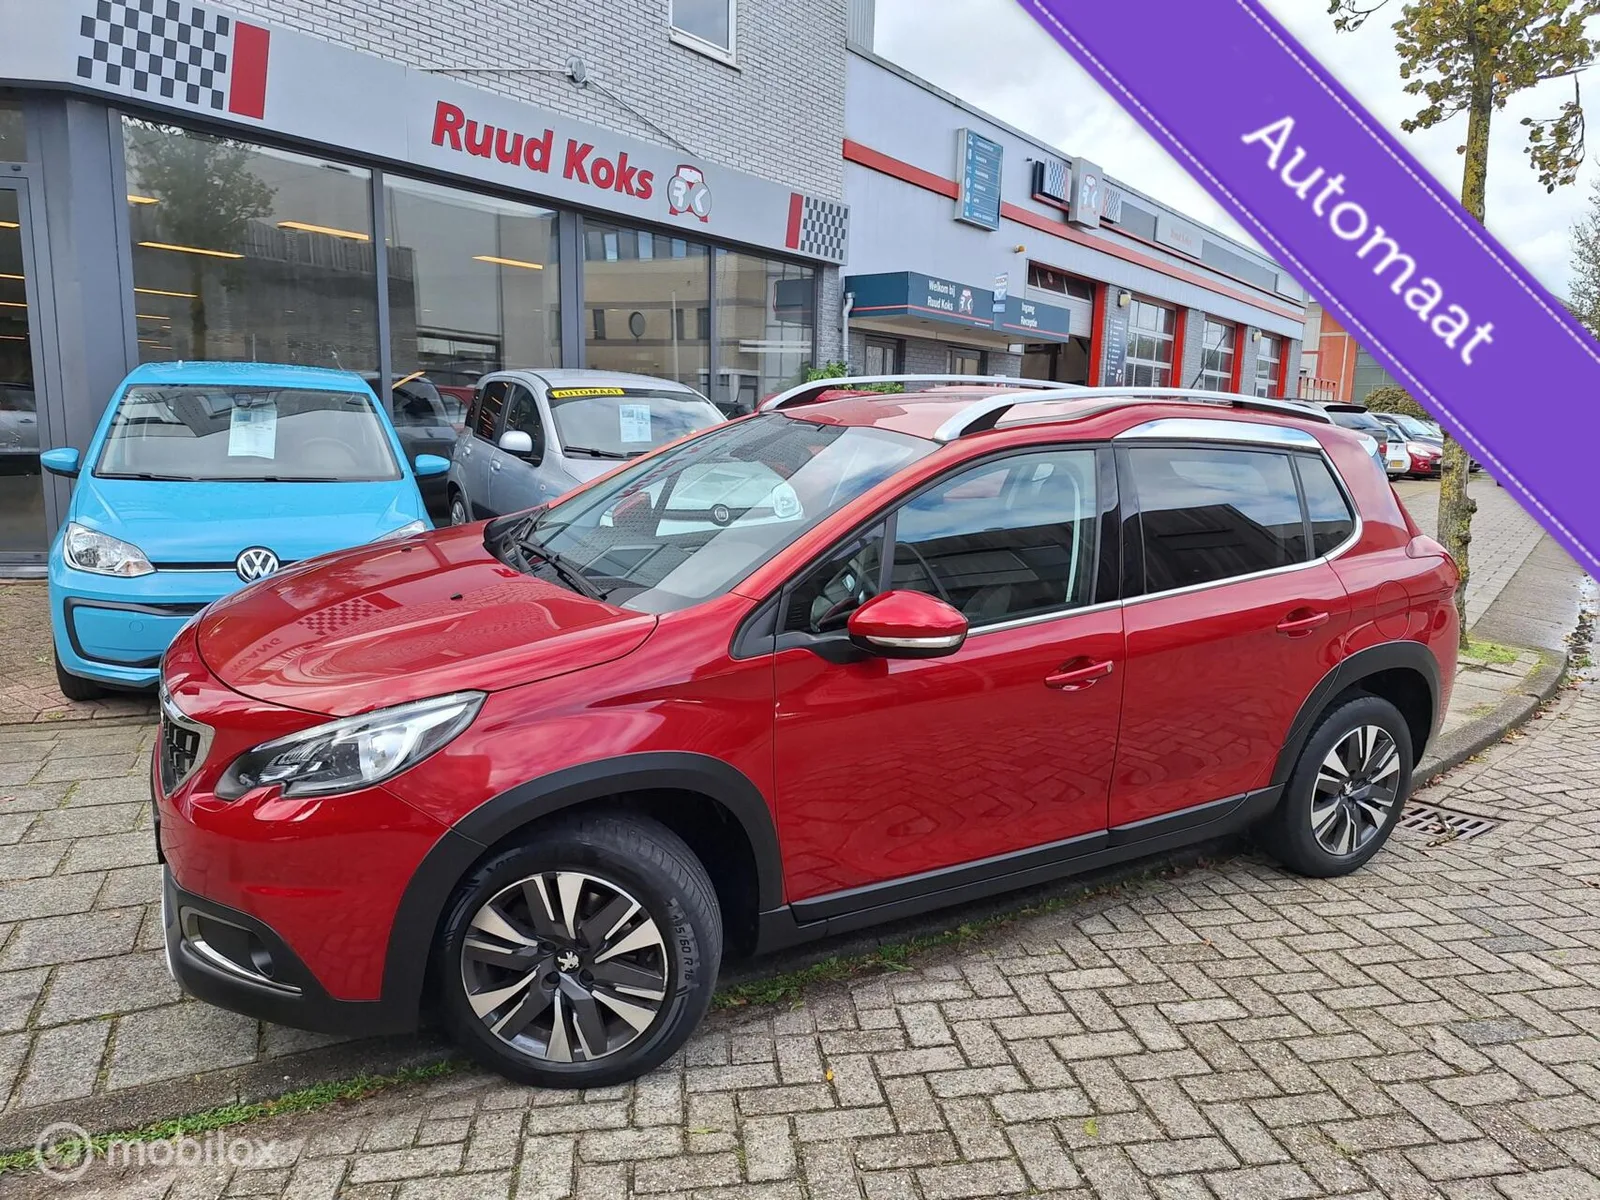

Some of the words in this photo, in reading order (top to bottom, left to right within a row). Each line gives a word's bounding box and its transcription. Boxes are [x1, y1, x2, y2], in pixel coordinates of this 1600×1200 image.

[431, 100, 554, 174] Ruud
[562, 138, 654, 200] Koks
[928, 280, 949, 295] Welkom
[927, 296, 940, 310] Ruud
[941, 299, 954, 313] Koks
[1021, 301, 1036, 316] Ingang
[557, 389, 619, 397] AUTOMAAT
